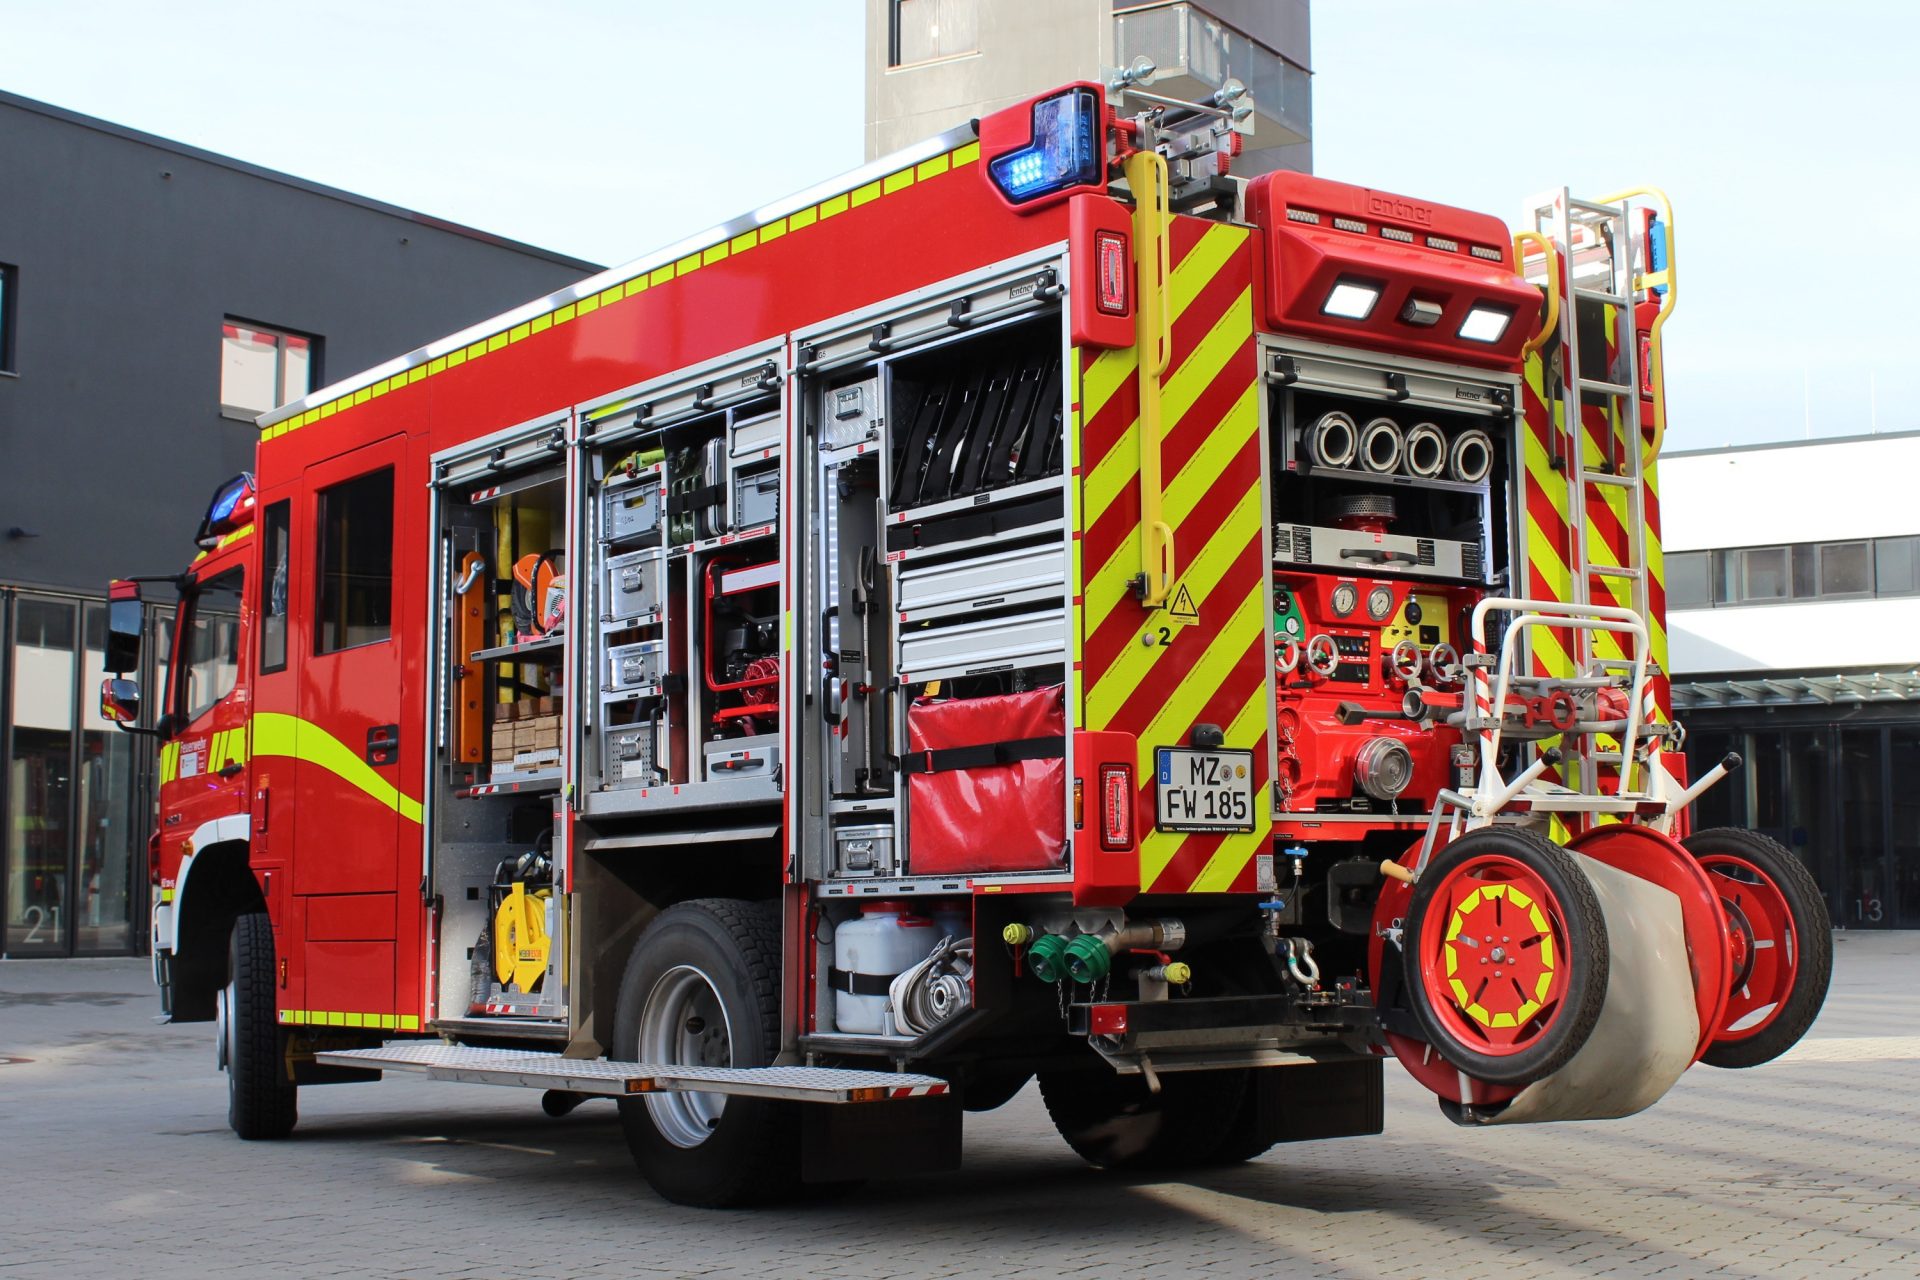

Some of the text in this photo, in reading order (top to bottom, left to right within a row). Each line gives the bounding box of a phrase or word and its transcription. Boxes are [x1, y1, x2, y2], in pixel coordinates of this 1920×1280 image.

[1158, 626, 1171, 646] 2
[1162, 771, 1168, 780] D
[1190, 757, 1221, 786] MZ
[1167, 789, 1247, 820] FW 185
[1855, 899, 1883, 922] 13
[22, 905, 60, 944] 21
